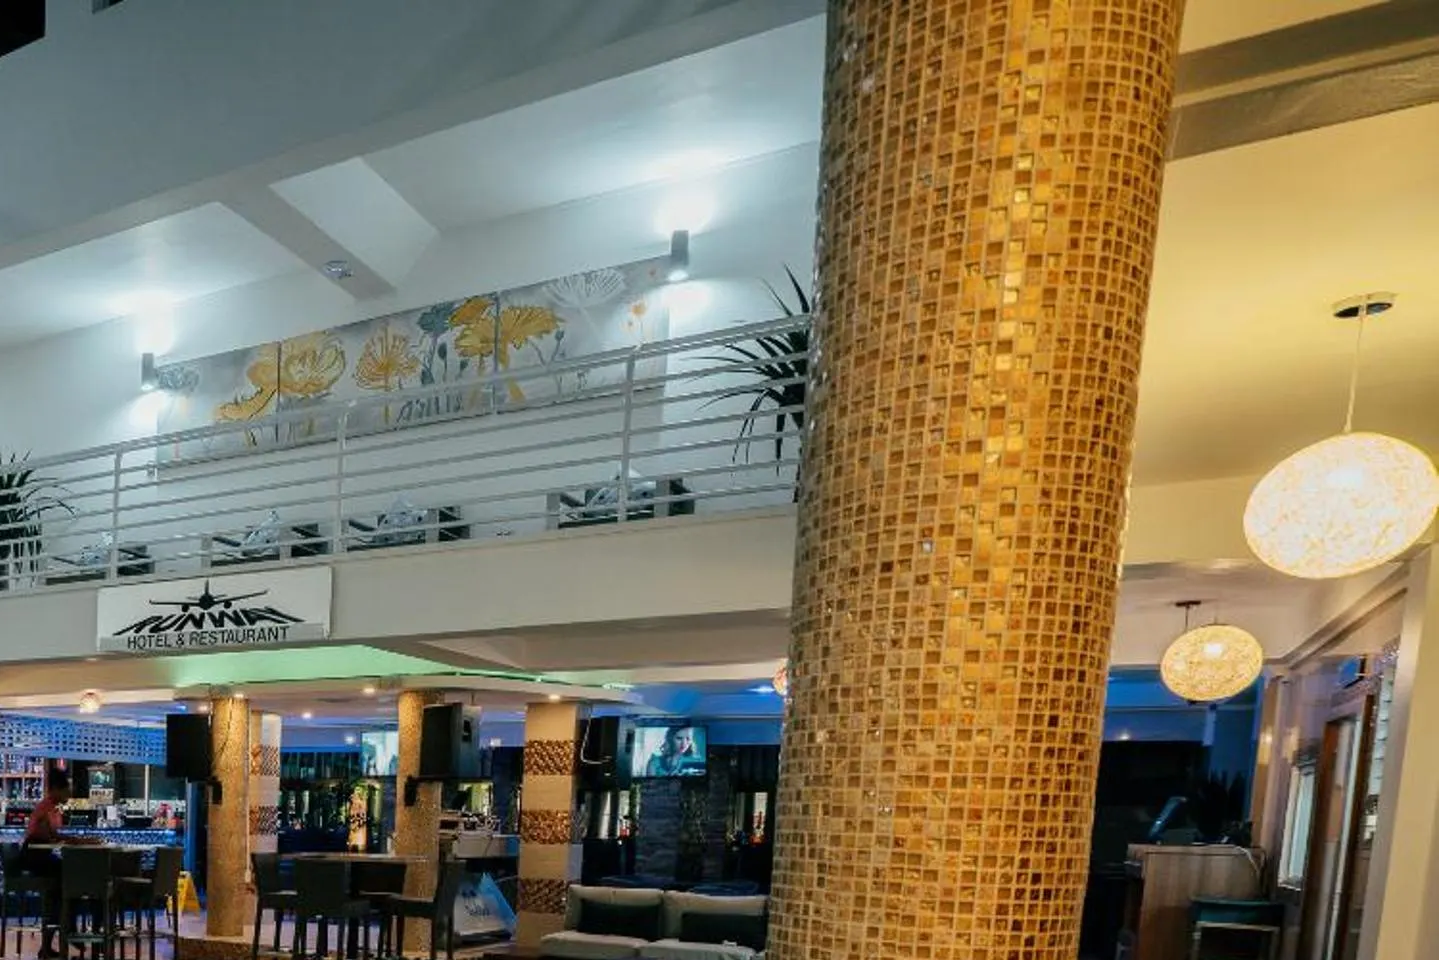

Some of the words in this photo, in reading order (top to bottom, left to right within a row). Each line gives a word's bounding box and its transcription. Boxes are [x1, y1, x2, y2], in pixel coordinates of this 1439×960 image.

[127, 634, 172, 649] HOTEL
[176, 632, 185, 647] &
[189, 626, 291, 646] RESTAURANT
